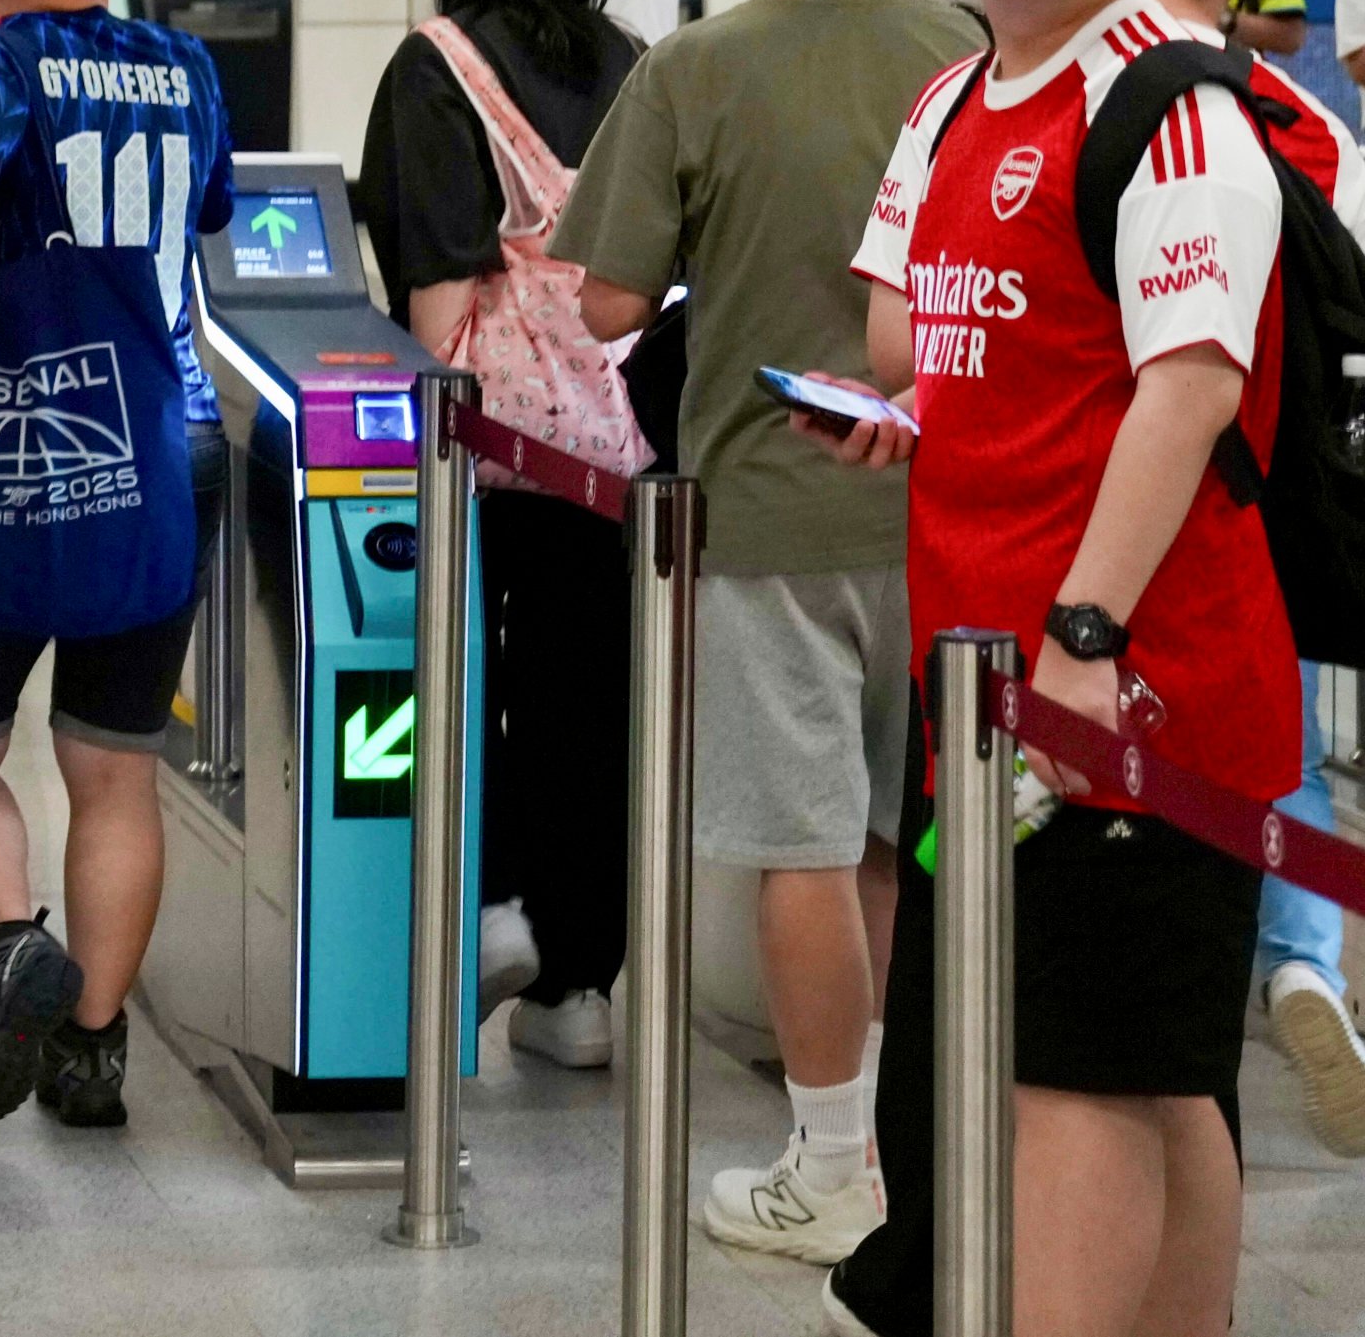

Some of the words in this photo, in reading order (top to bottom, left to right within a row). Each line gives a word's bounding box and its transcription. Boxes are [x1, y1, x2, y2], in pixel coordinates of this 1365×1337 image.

[38, 56, 191, 108] GYOKERES
[878, 177, 902, 201] SIT
[1160, 233, 1218, 267] VISIT
[1138, 258, 1229, 302] RWANDA
[47, 465, 140, 504] 2025
[25, 504, 81, 526] HONG
[83, 490, 143, 516] KONG
